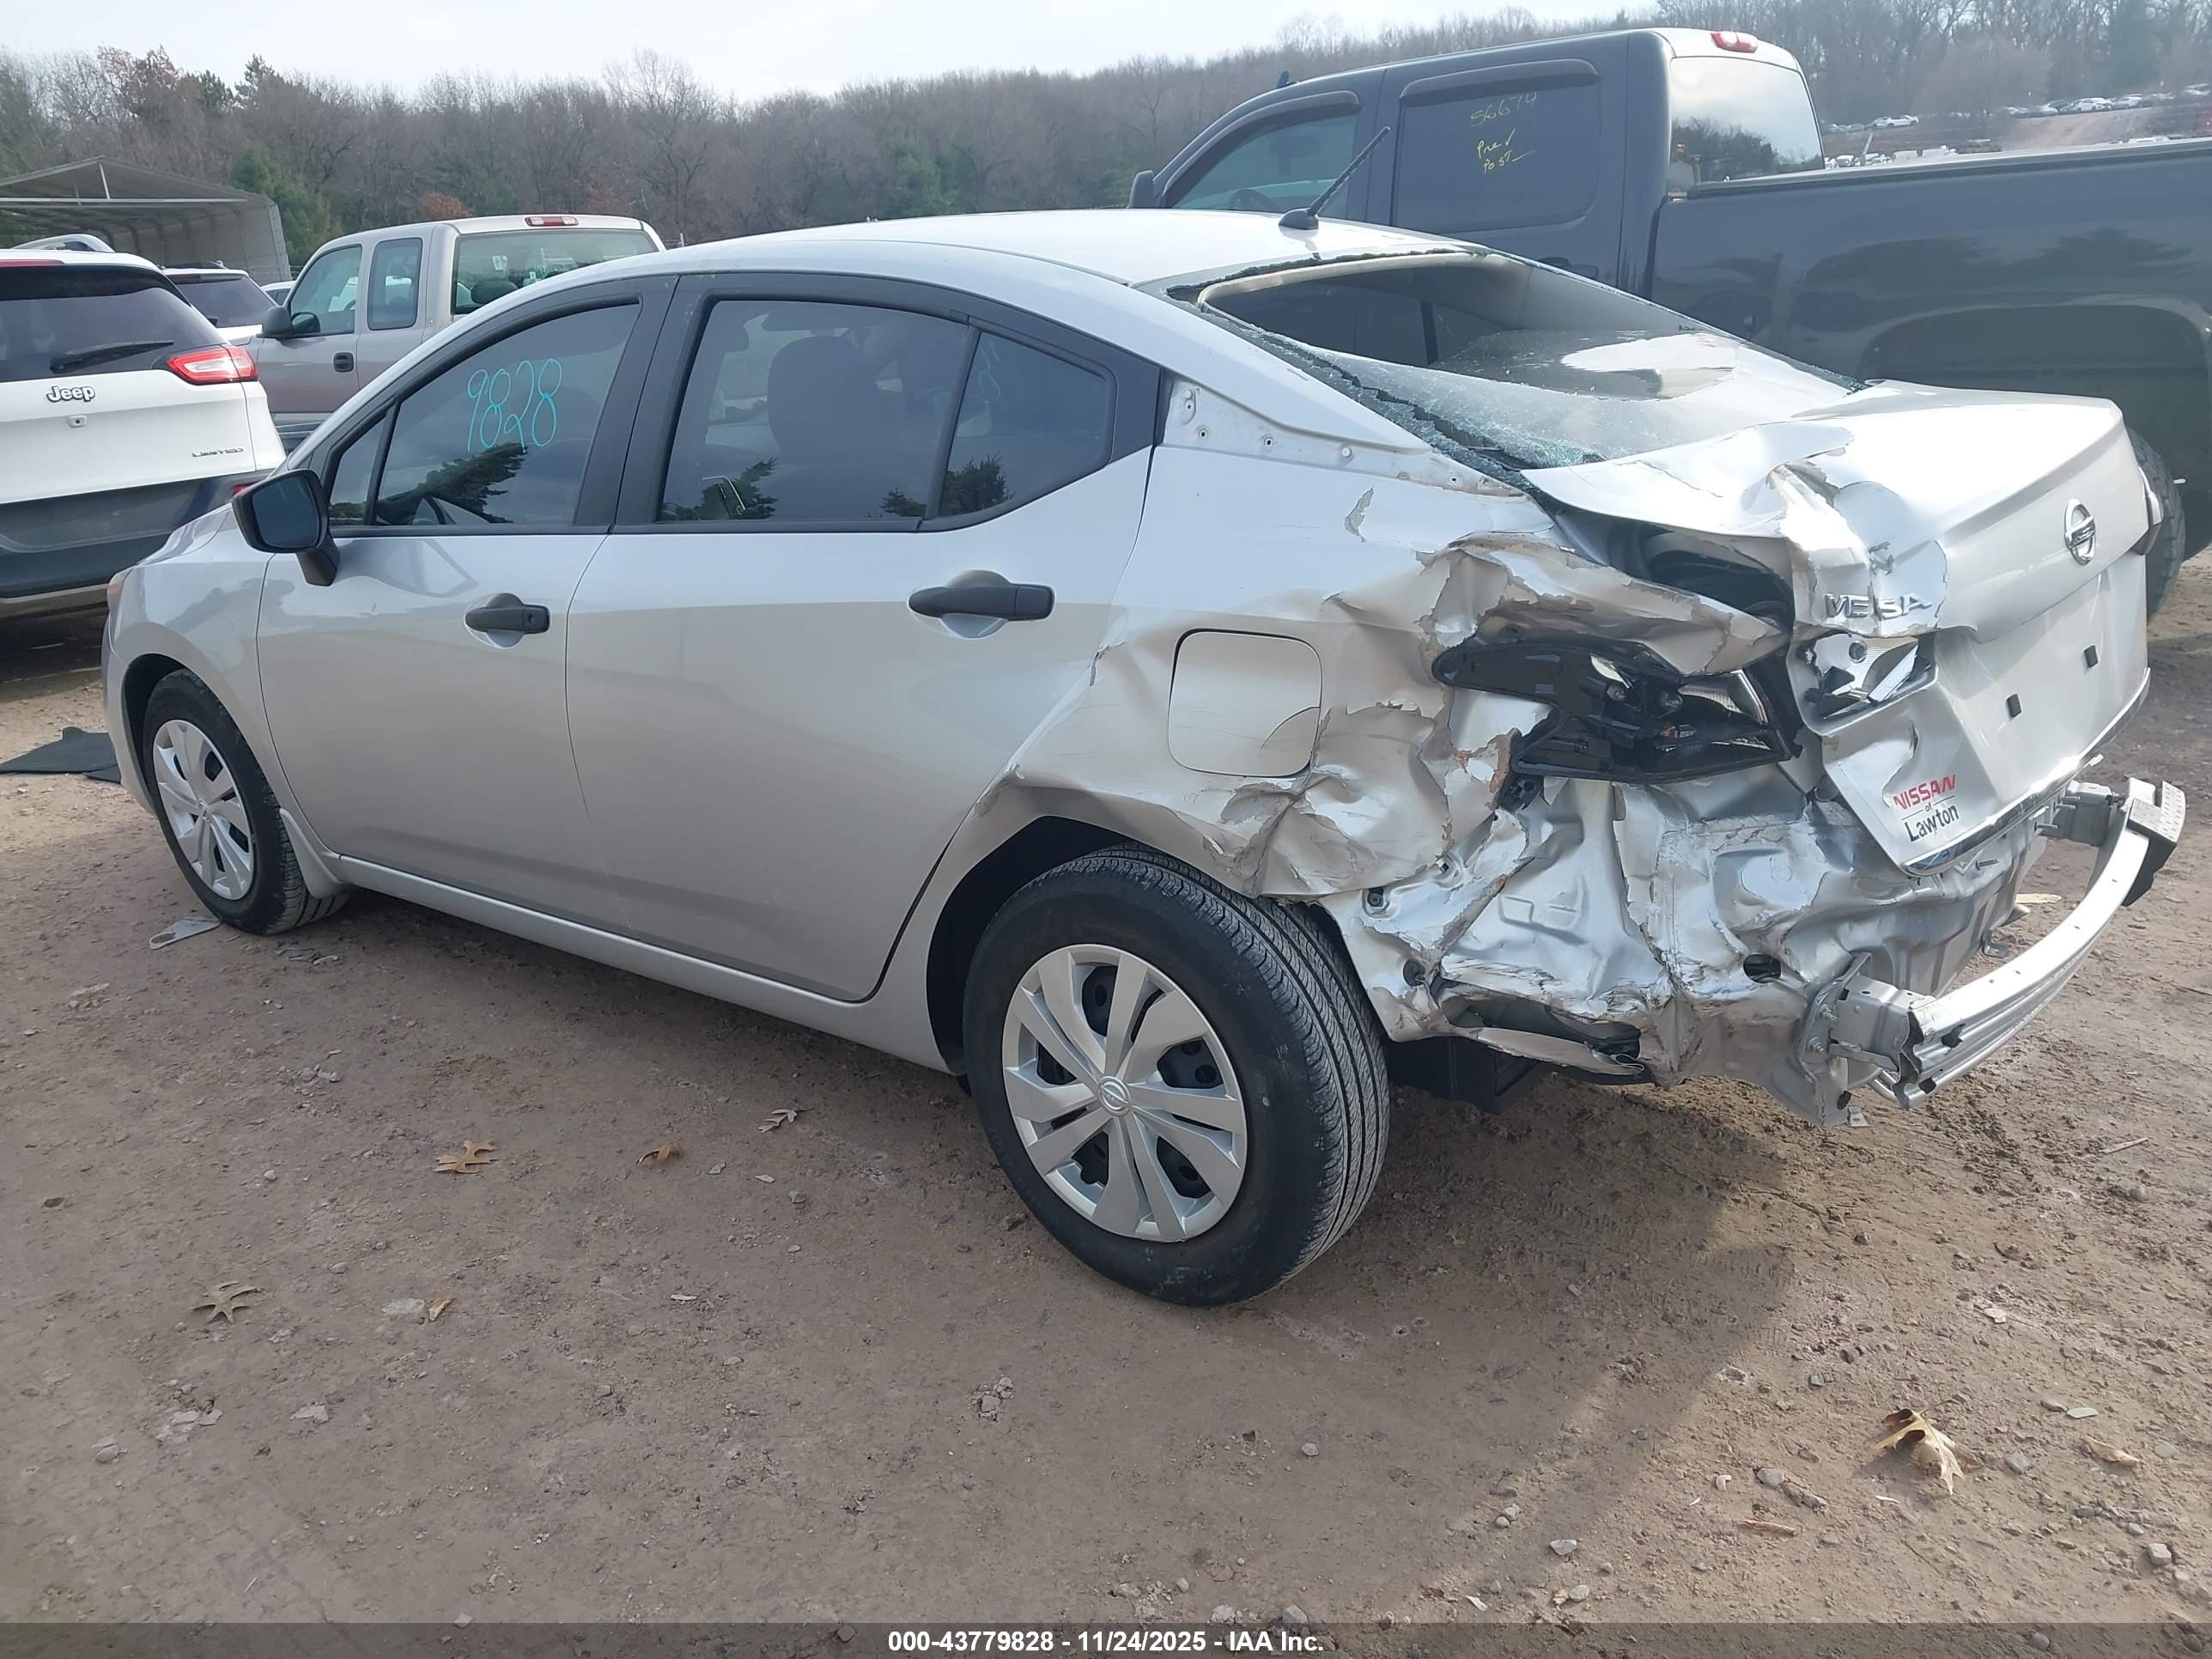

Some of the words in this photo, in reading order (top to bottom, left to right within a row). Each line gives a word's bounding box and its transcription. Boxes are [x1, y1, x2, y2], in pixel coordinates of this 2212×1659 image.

[46, 386, 95, 403] Jeep
[467, 357, 562, 453] 9828
[1893, 774, 1956, 810] NISSAN
[1924, 802, 1932, 812] of
[1905, 805, 1960, 842] Lawton
